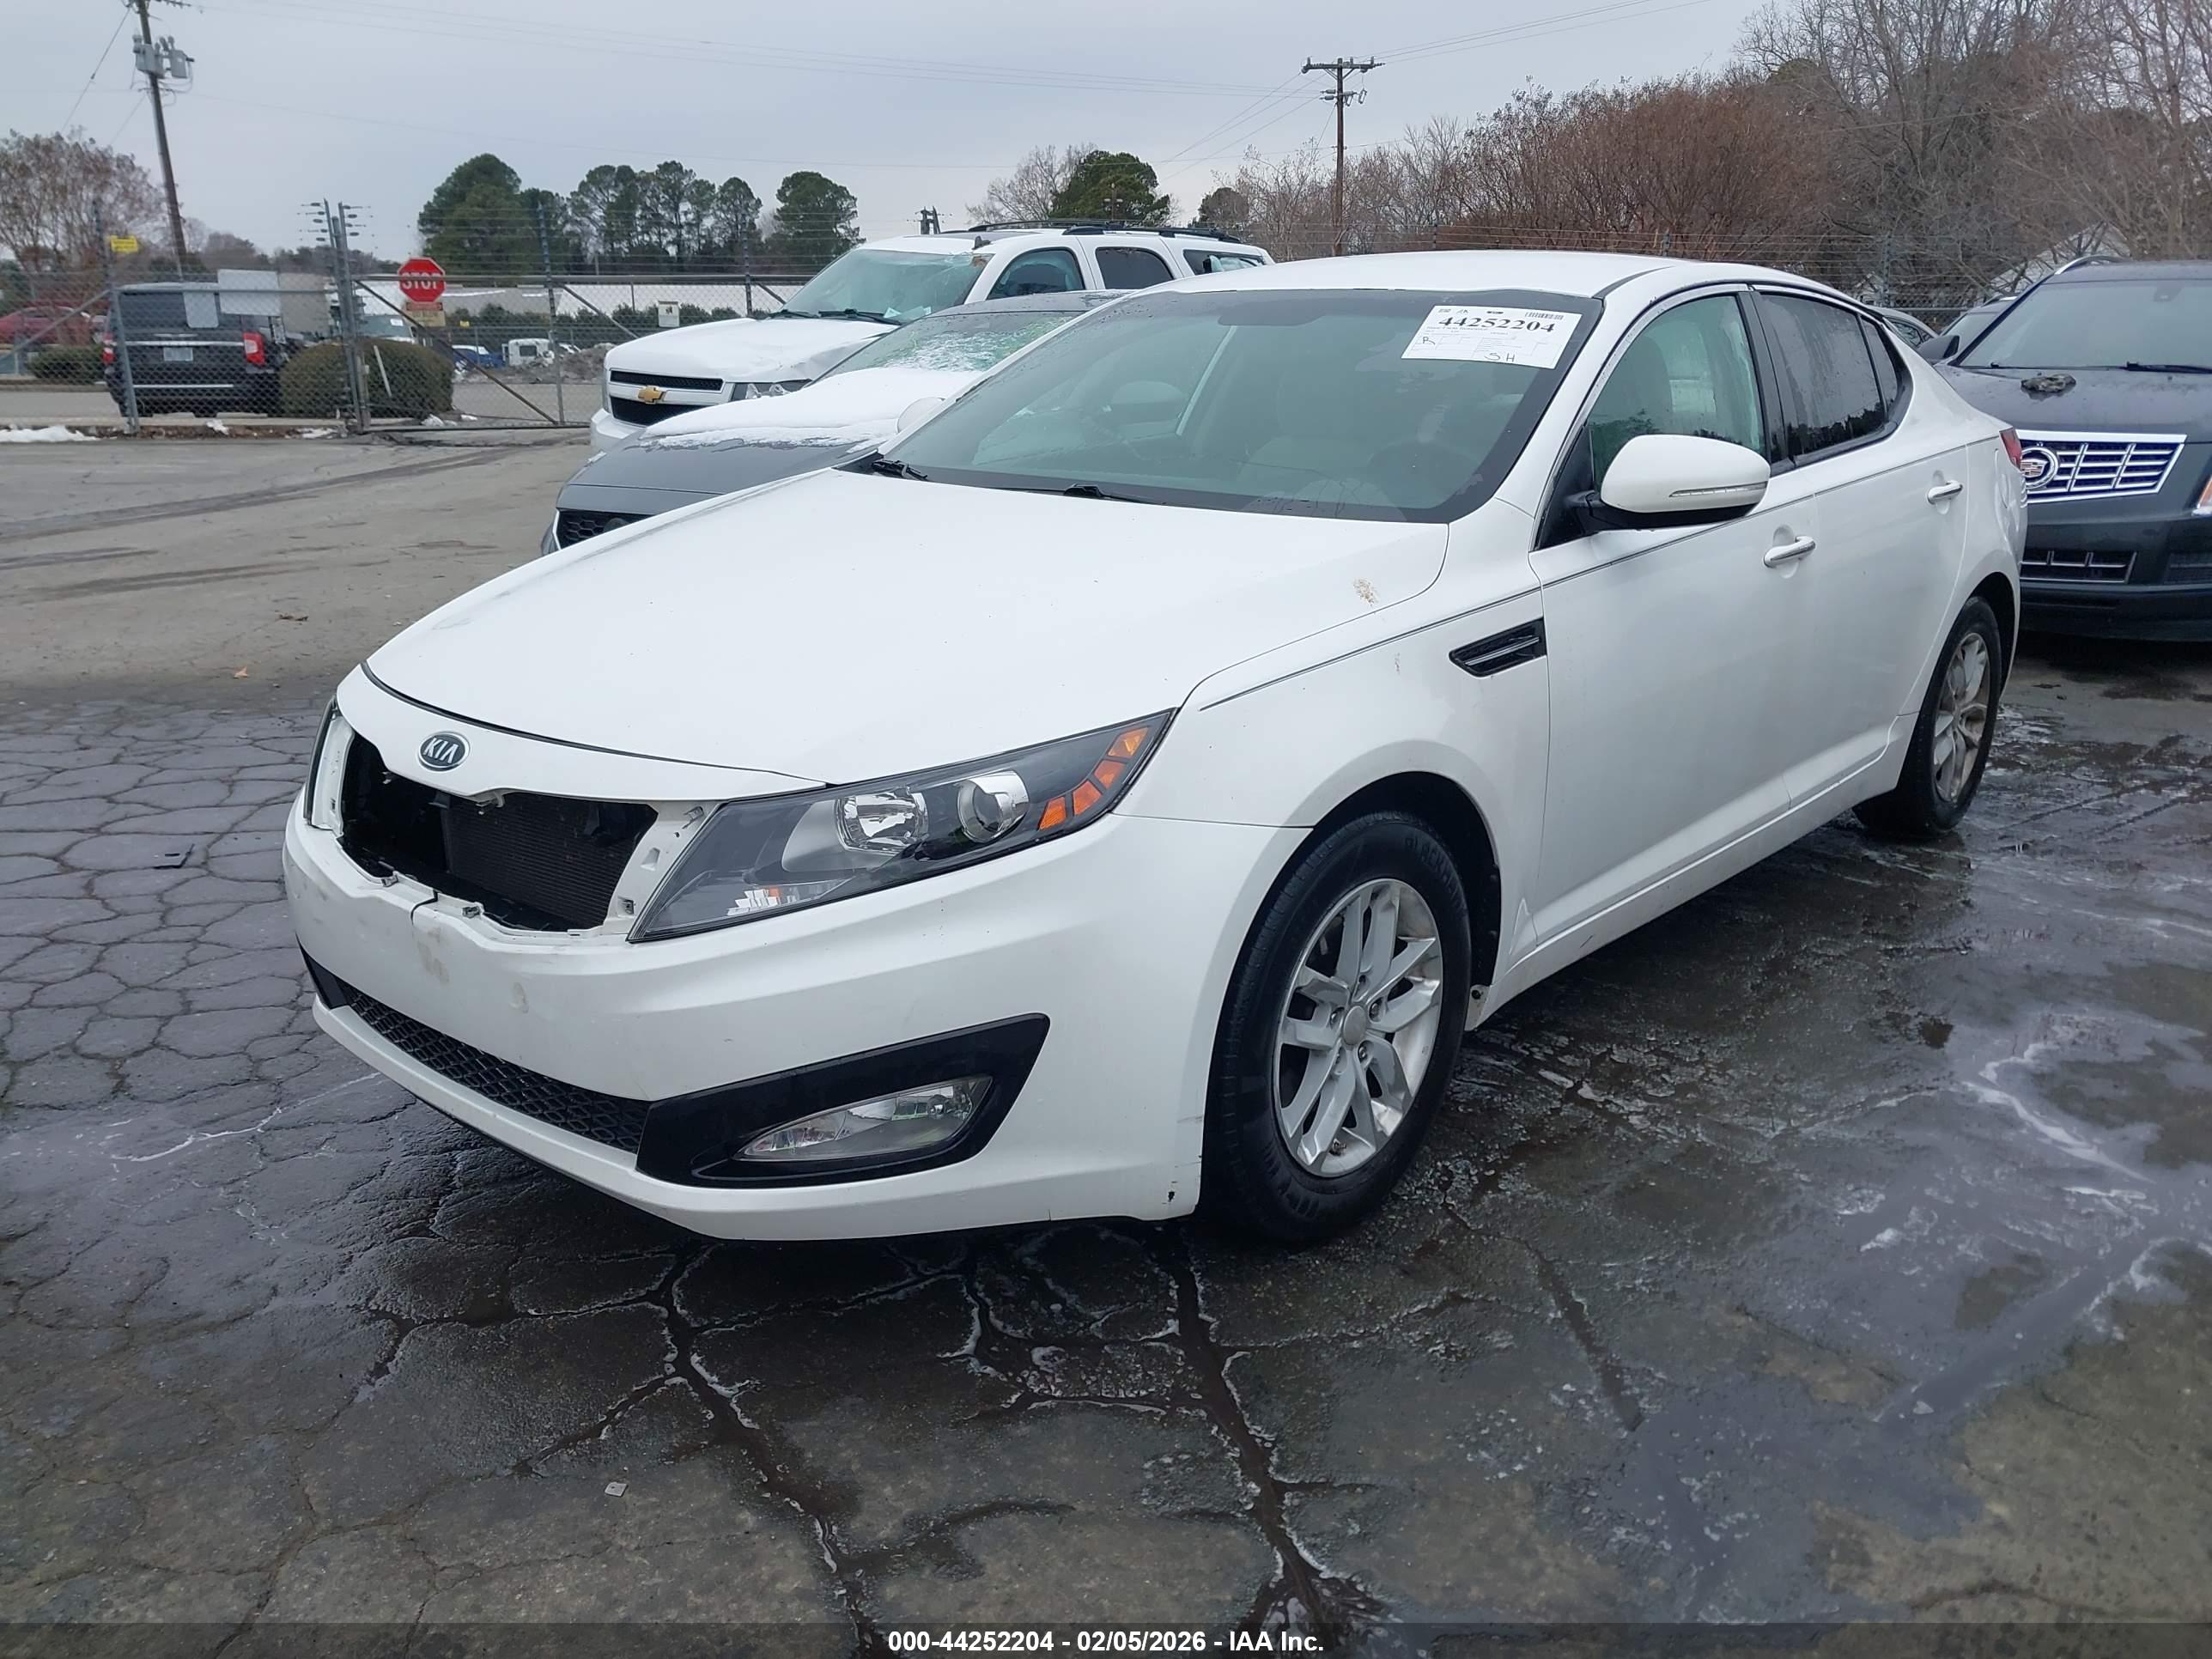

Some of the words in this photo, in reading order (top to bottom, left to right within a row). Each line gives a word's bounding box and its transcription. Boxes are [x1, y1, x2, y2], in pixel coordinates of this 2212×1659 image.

[402, 271, 441, 289] STOP
[1437, 315, 1556, 333] 44252204
[422, 737, 459, 764] KIA
